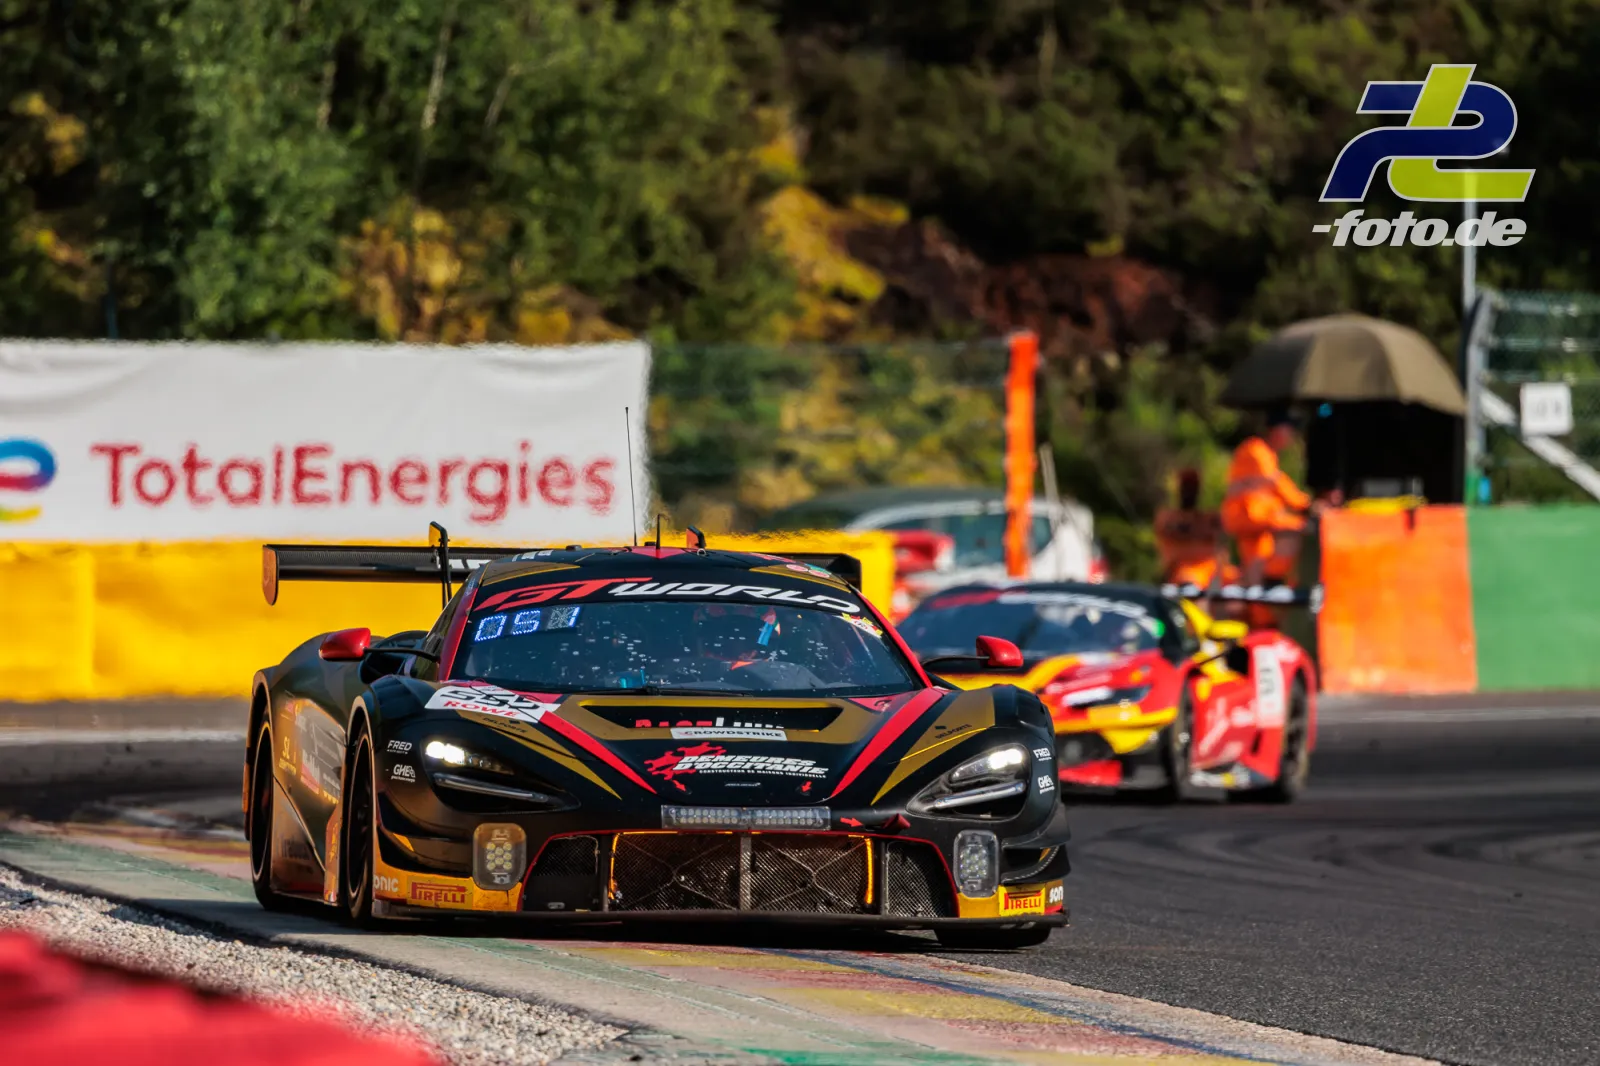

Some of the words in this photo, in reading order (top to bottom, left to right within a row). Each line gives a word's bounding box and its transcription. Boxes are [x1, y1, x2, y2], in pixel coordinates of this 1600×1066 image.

[91, 440, 617, 525] TotalEnergies
[473, 577, 653, 612] GT
[608, 582, 861, 613] WORLD
[443, 701, 520, 717] ROWE
[684, 730, 783, 738] CROWDSTRIKE
[387, 740, 413, 751] FRED
[673, 762, 829, 775] D'OCCITANIE
[679, 755, 817, 767] DEMEURES
[411, 882, 466, 904] PIRELLI
[1003, 890, 1043, 910] PIRELLI
